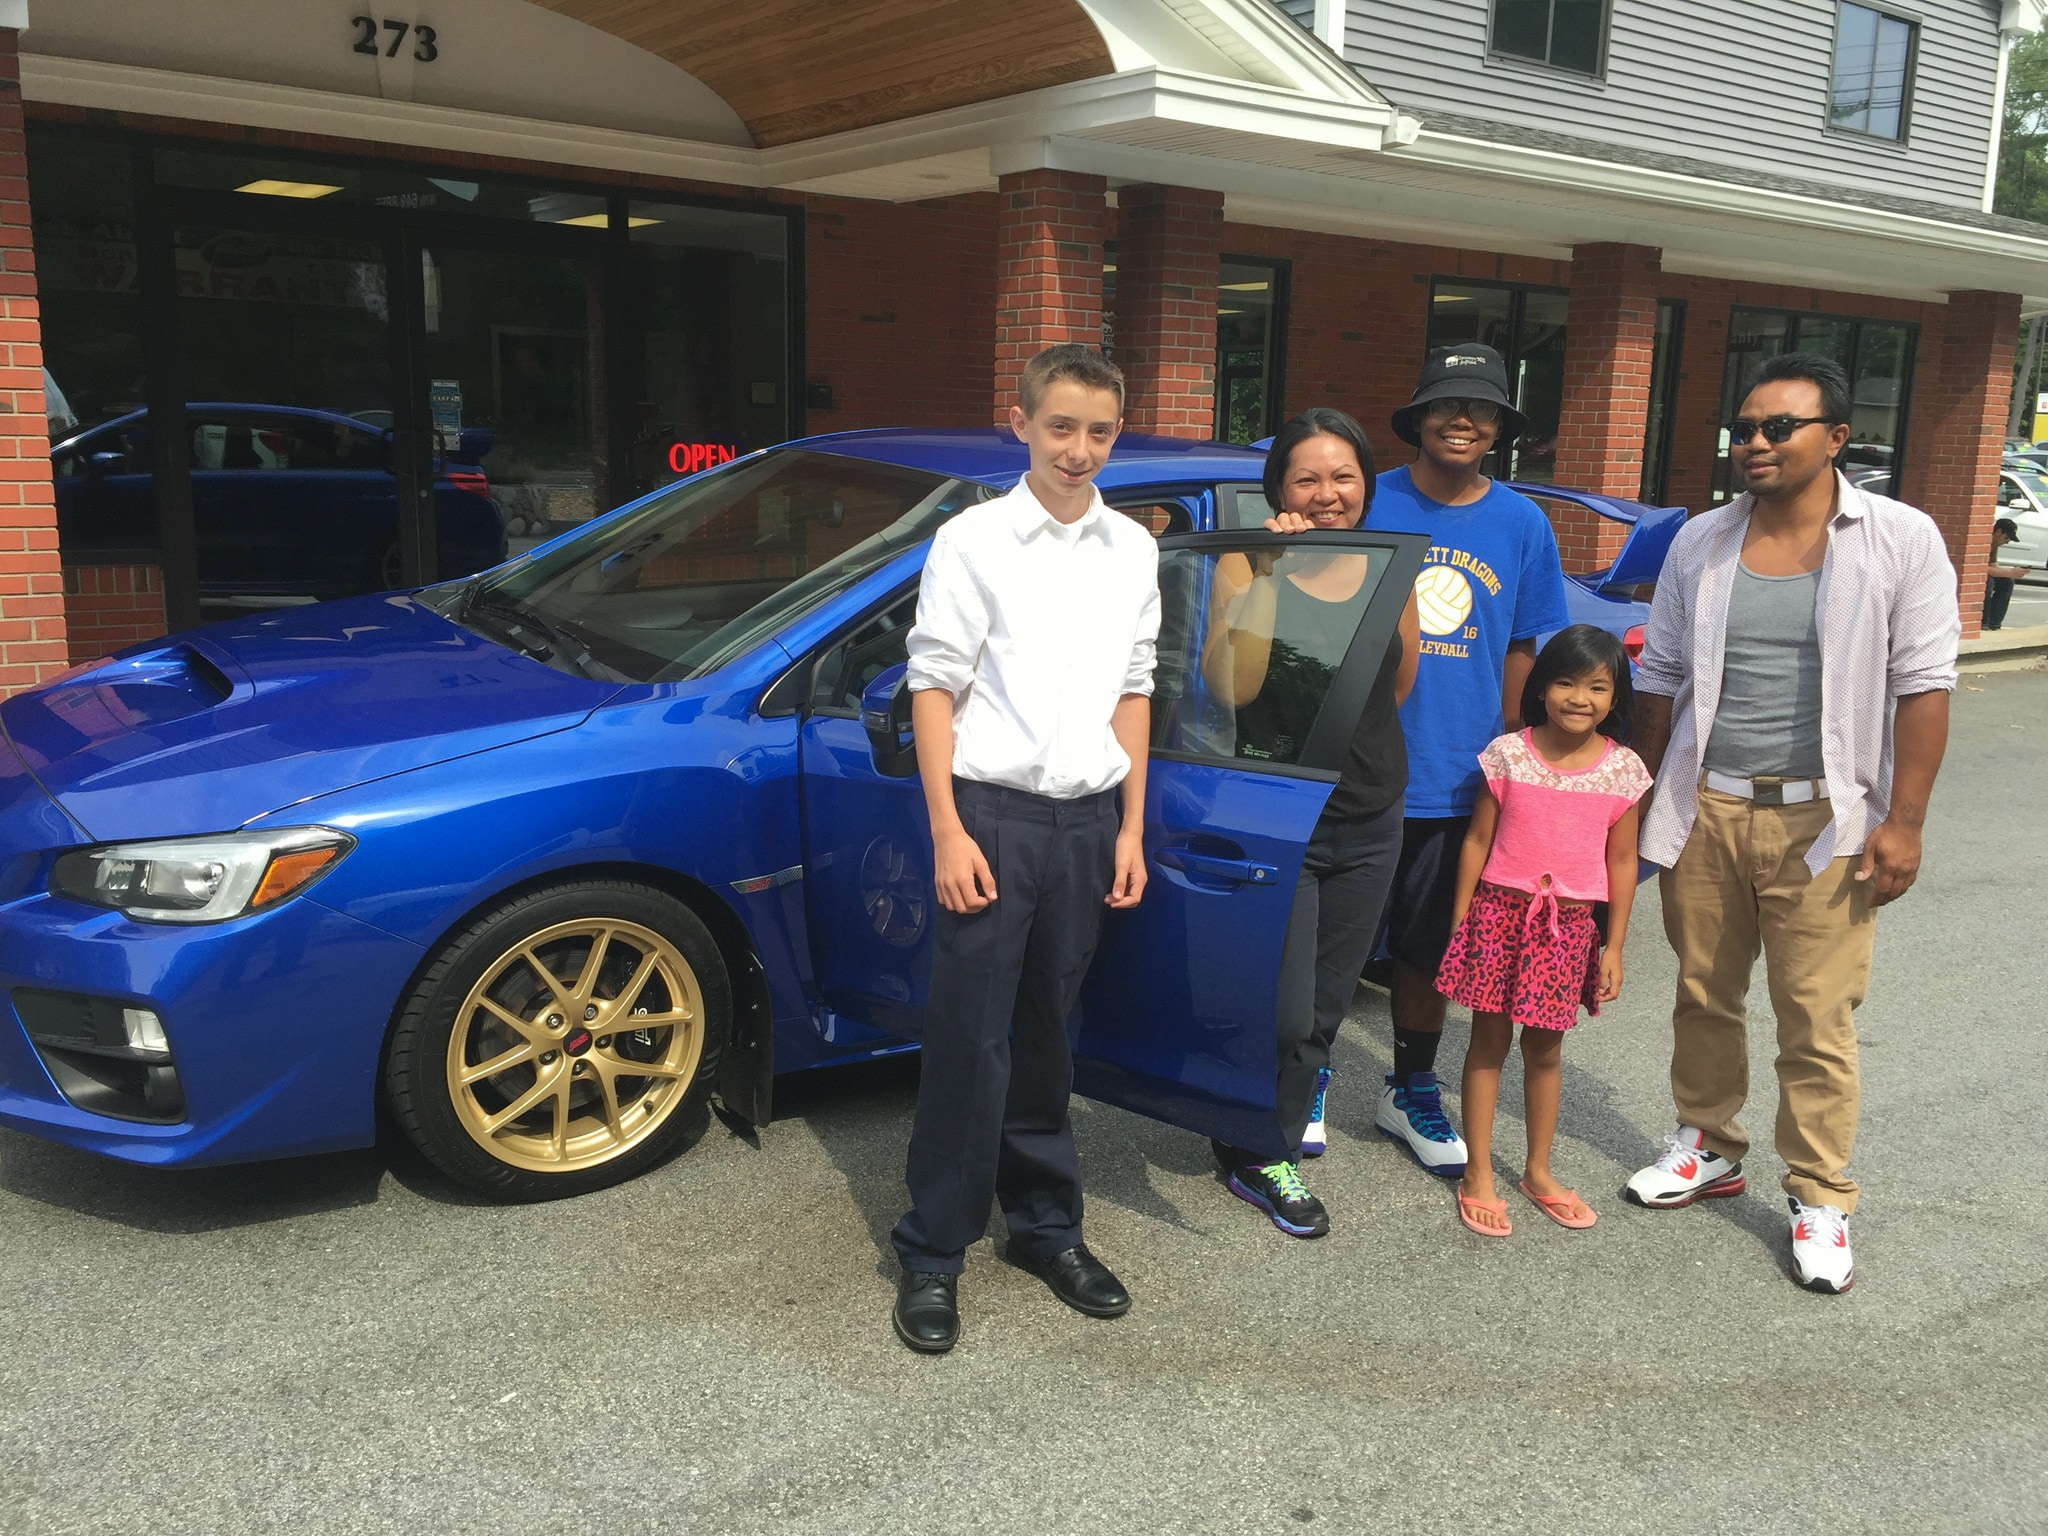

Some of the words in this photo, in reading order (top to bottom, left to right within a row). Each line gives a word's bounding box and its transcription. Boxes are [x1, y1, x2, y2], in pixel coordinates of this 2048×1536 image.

[352, 16, 438, 62] 273
[669, 443, 735, 473] OPEN
[1450, 549, 1502, 597] DRAGONS
[1463, 626, 1478, 640] 16
[1419, 640, 1469, 658] LEYBALL
